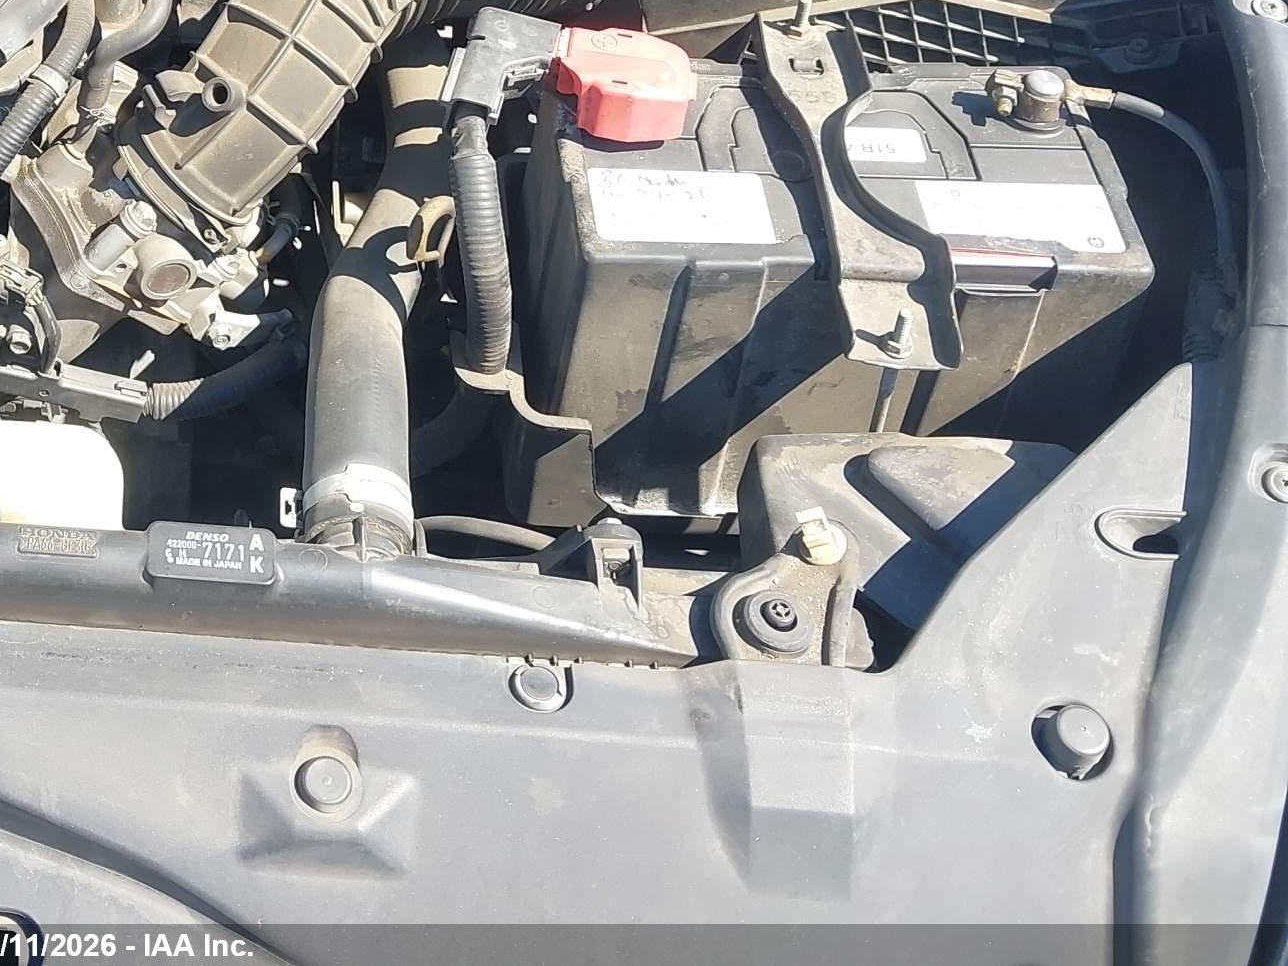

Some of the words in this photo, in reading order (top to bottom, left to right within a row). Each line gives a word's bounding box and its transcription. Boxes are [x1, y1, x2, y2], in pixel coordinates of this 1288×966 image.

[185, 531, 229, 542] DENSO
[249, 534, 264, 551] A
[175, 557, 200, 566] MADE
[202, 559, 211, 567] IN
[214, 560, 242, 570] JAPAN
[249, 555, 264, 573] K
